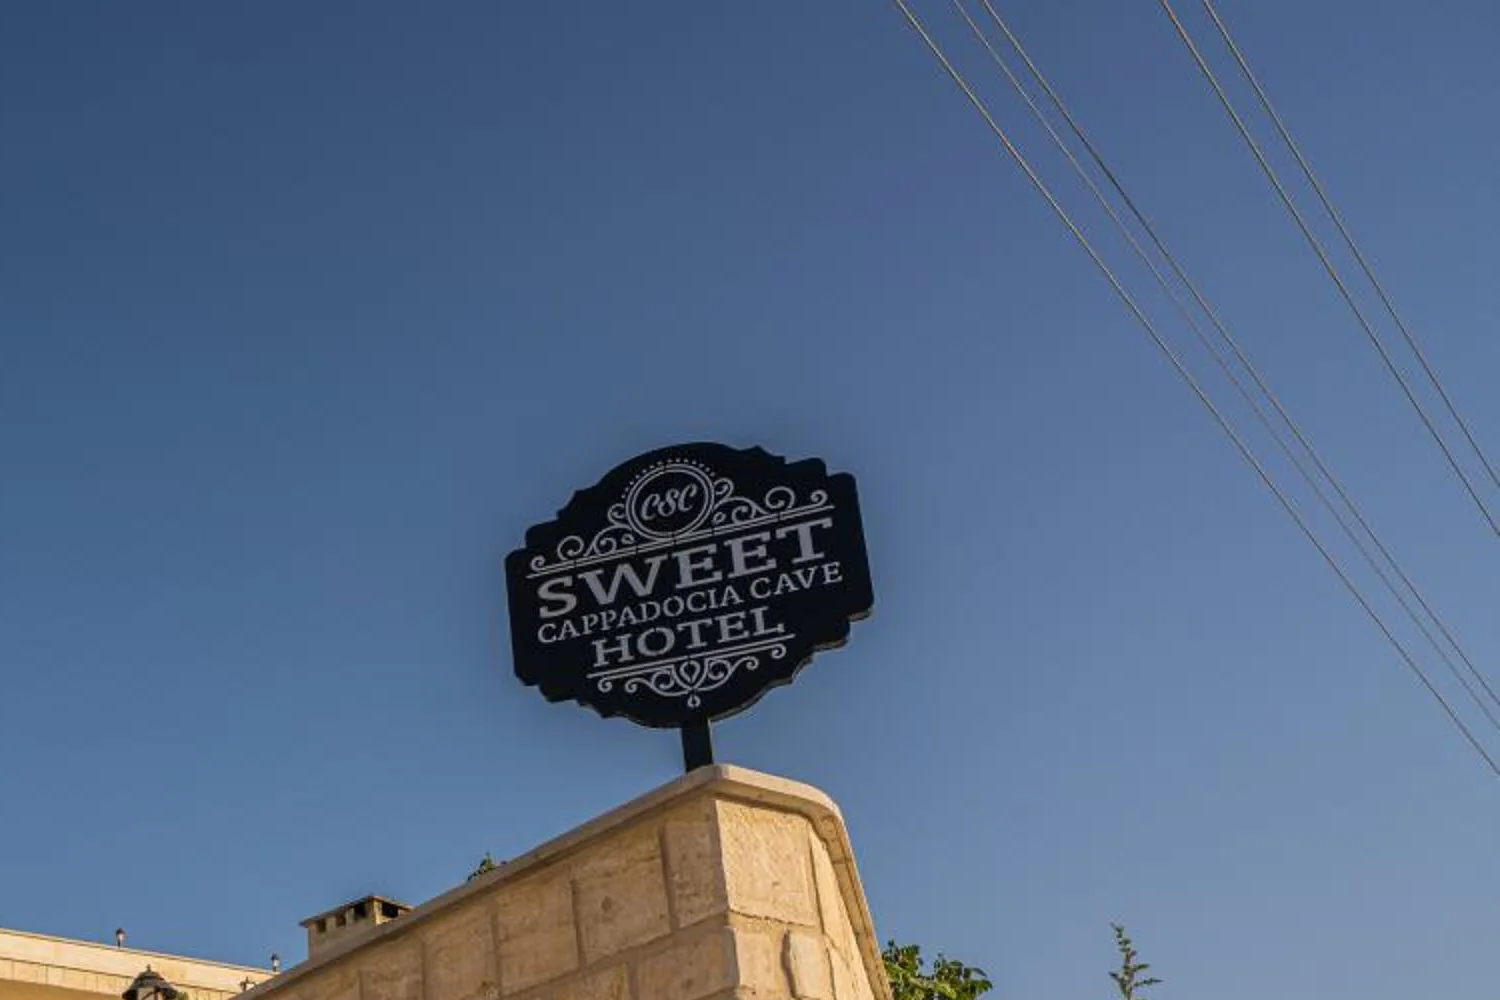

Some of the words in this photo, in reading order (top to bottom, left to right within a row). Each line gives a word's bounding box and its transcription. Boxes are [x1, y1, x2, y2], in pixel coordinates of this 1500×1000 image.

[536, 517, 834, 619] SWEET
[537, 584, 744, 643] CAPPADOCIA
[750, 561, 843, 600] CAVE
[592, 606, 785, 668] HOTEL
